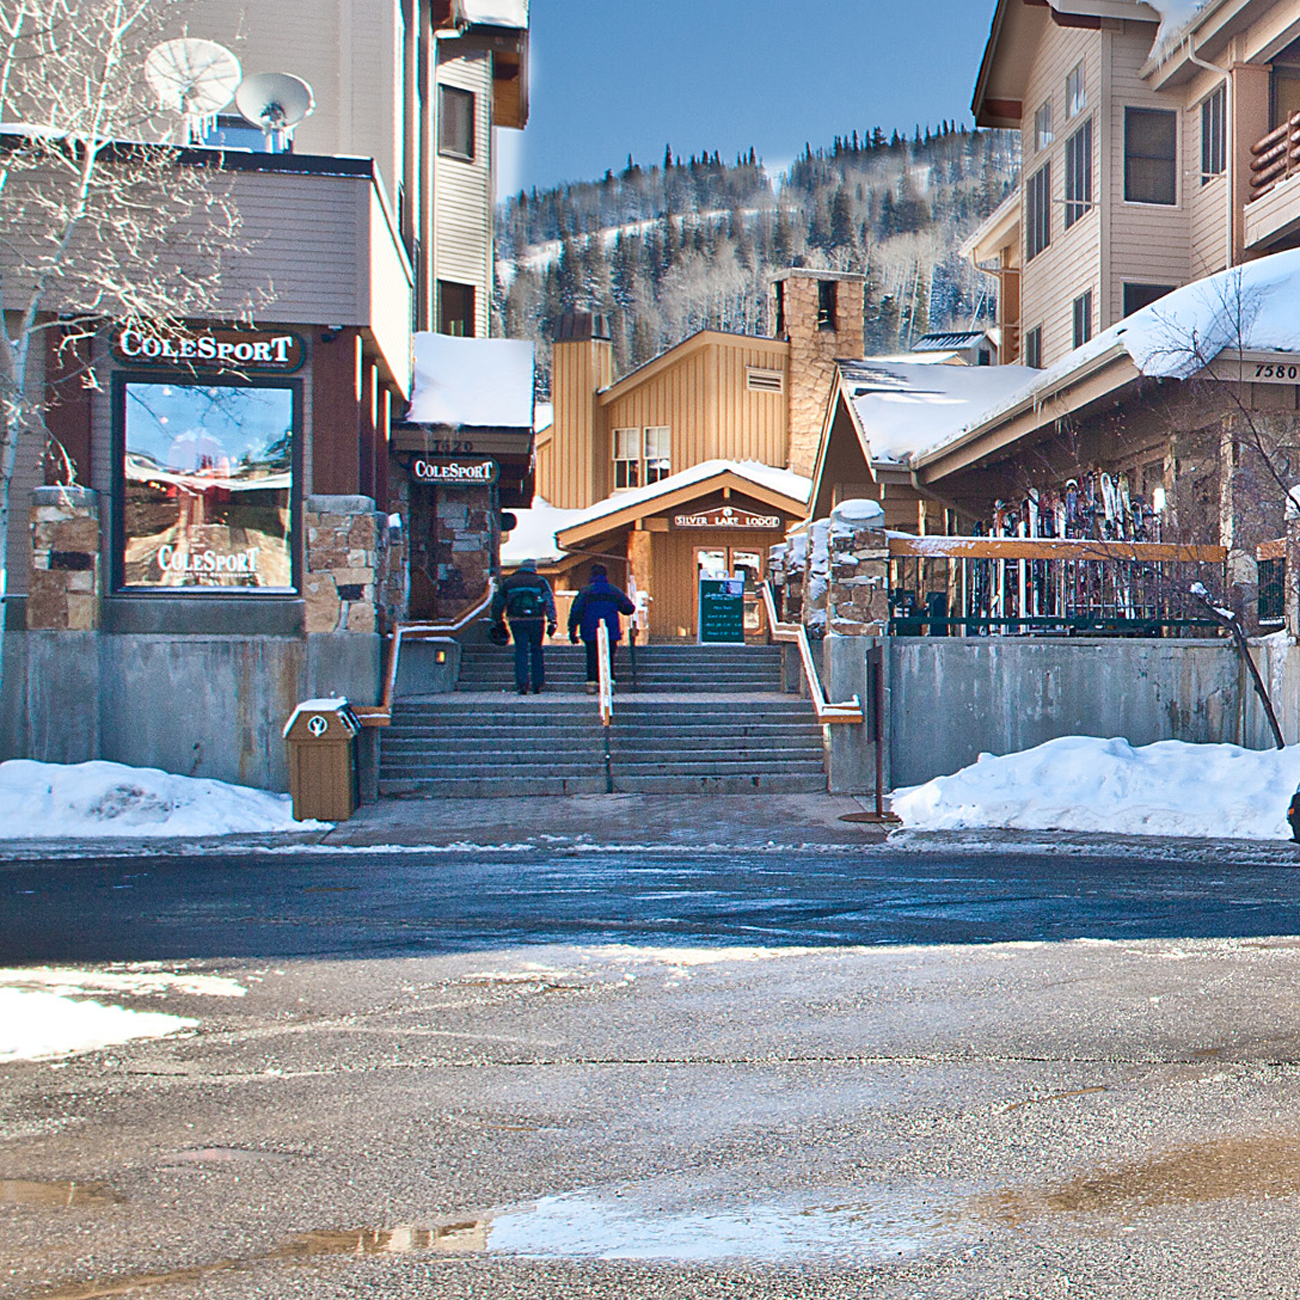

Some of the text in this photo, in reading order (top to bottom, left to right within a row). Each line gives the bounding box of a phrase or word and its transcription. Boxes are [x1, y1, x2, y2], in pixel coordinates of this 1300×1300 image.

[1255, 364, 1298, 380] 7580
[677, 516, 778, 525] SILVER LAKE LODGE
